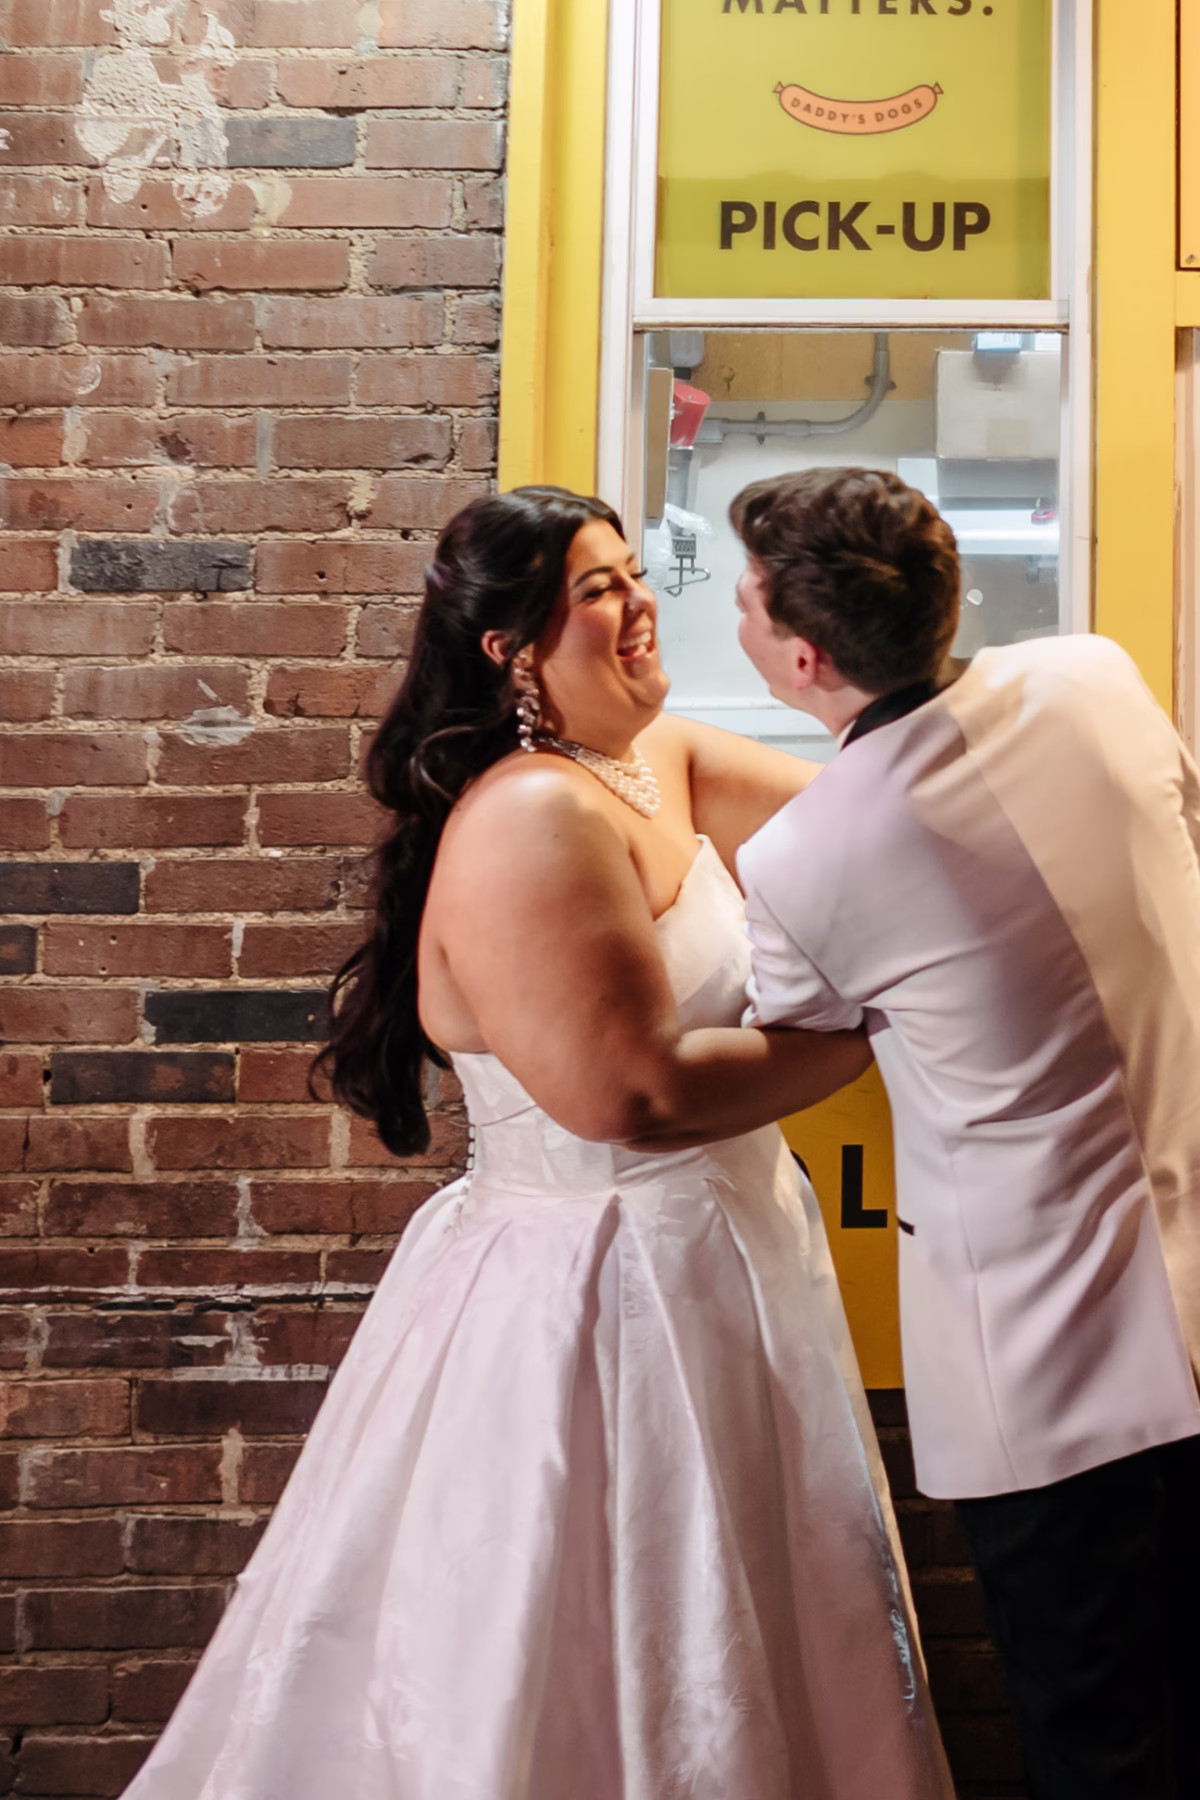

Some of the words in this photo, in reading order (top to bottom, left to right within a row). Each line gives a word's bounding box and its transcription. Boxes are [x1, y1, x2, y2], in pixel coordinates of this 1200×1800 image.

[791, 97, 866, 125] DADDY'S
[874, 98, 923, 122] DOGS
[719, 200, 992, 252] PICK-UP
